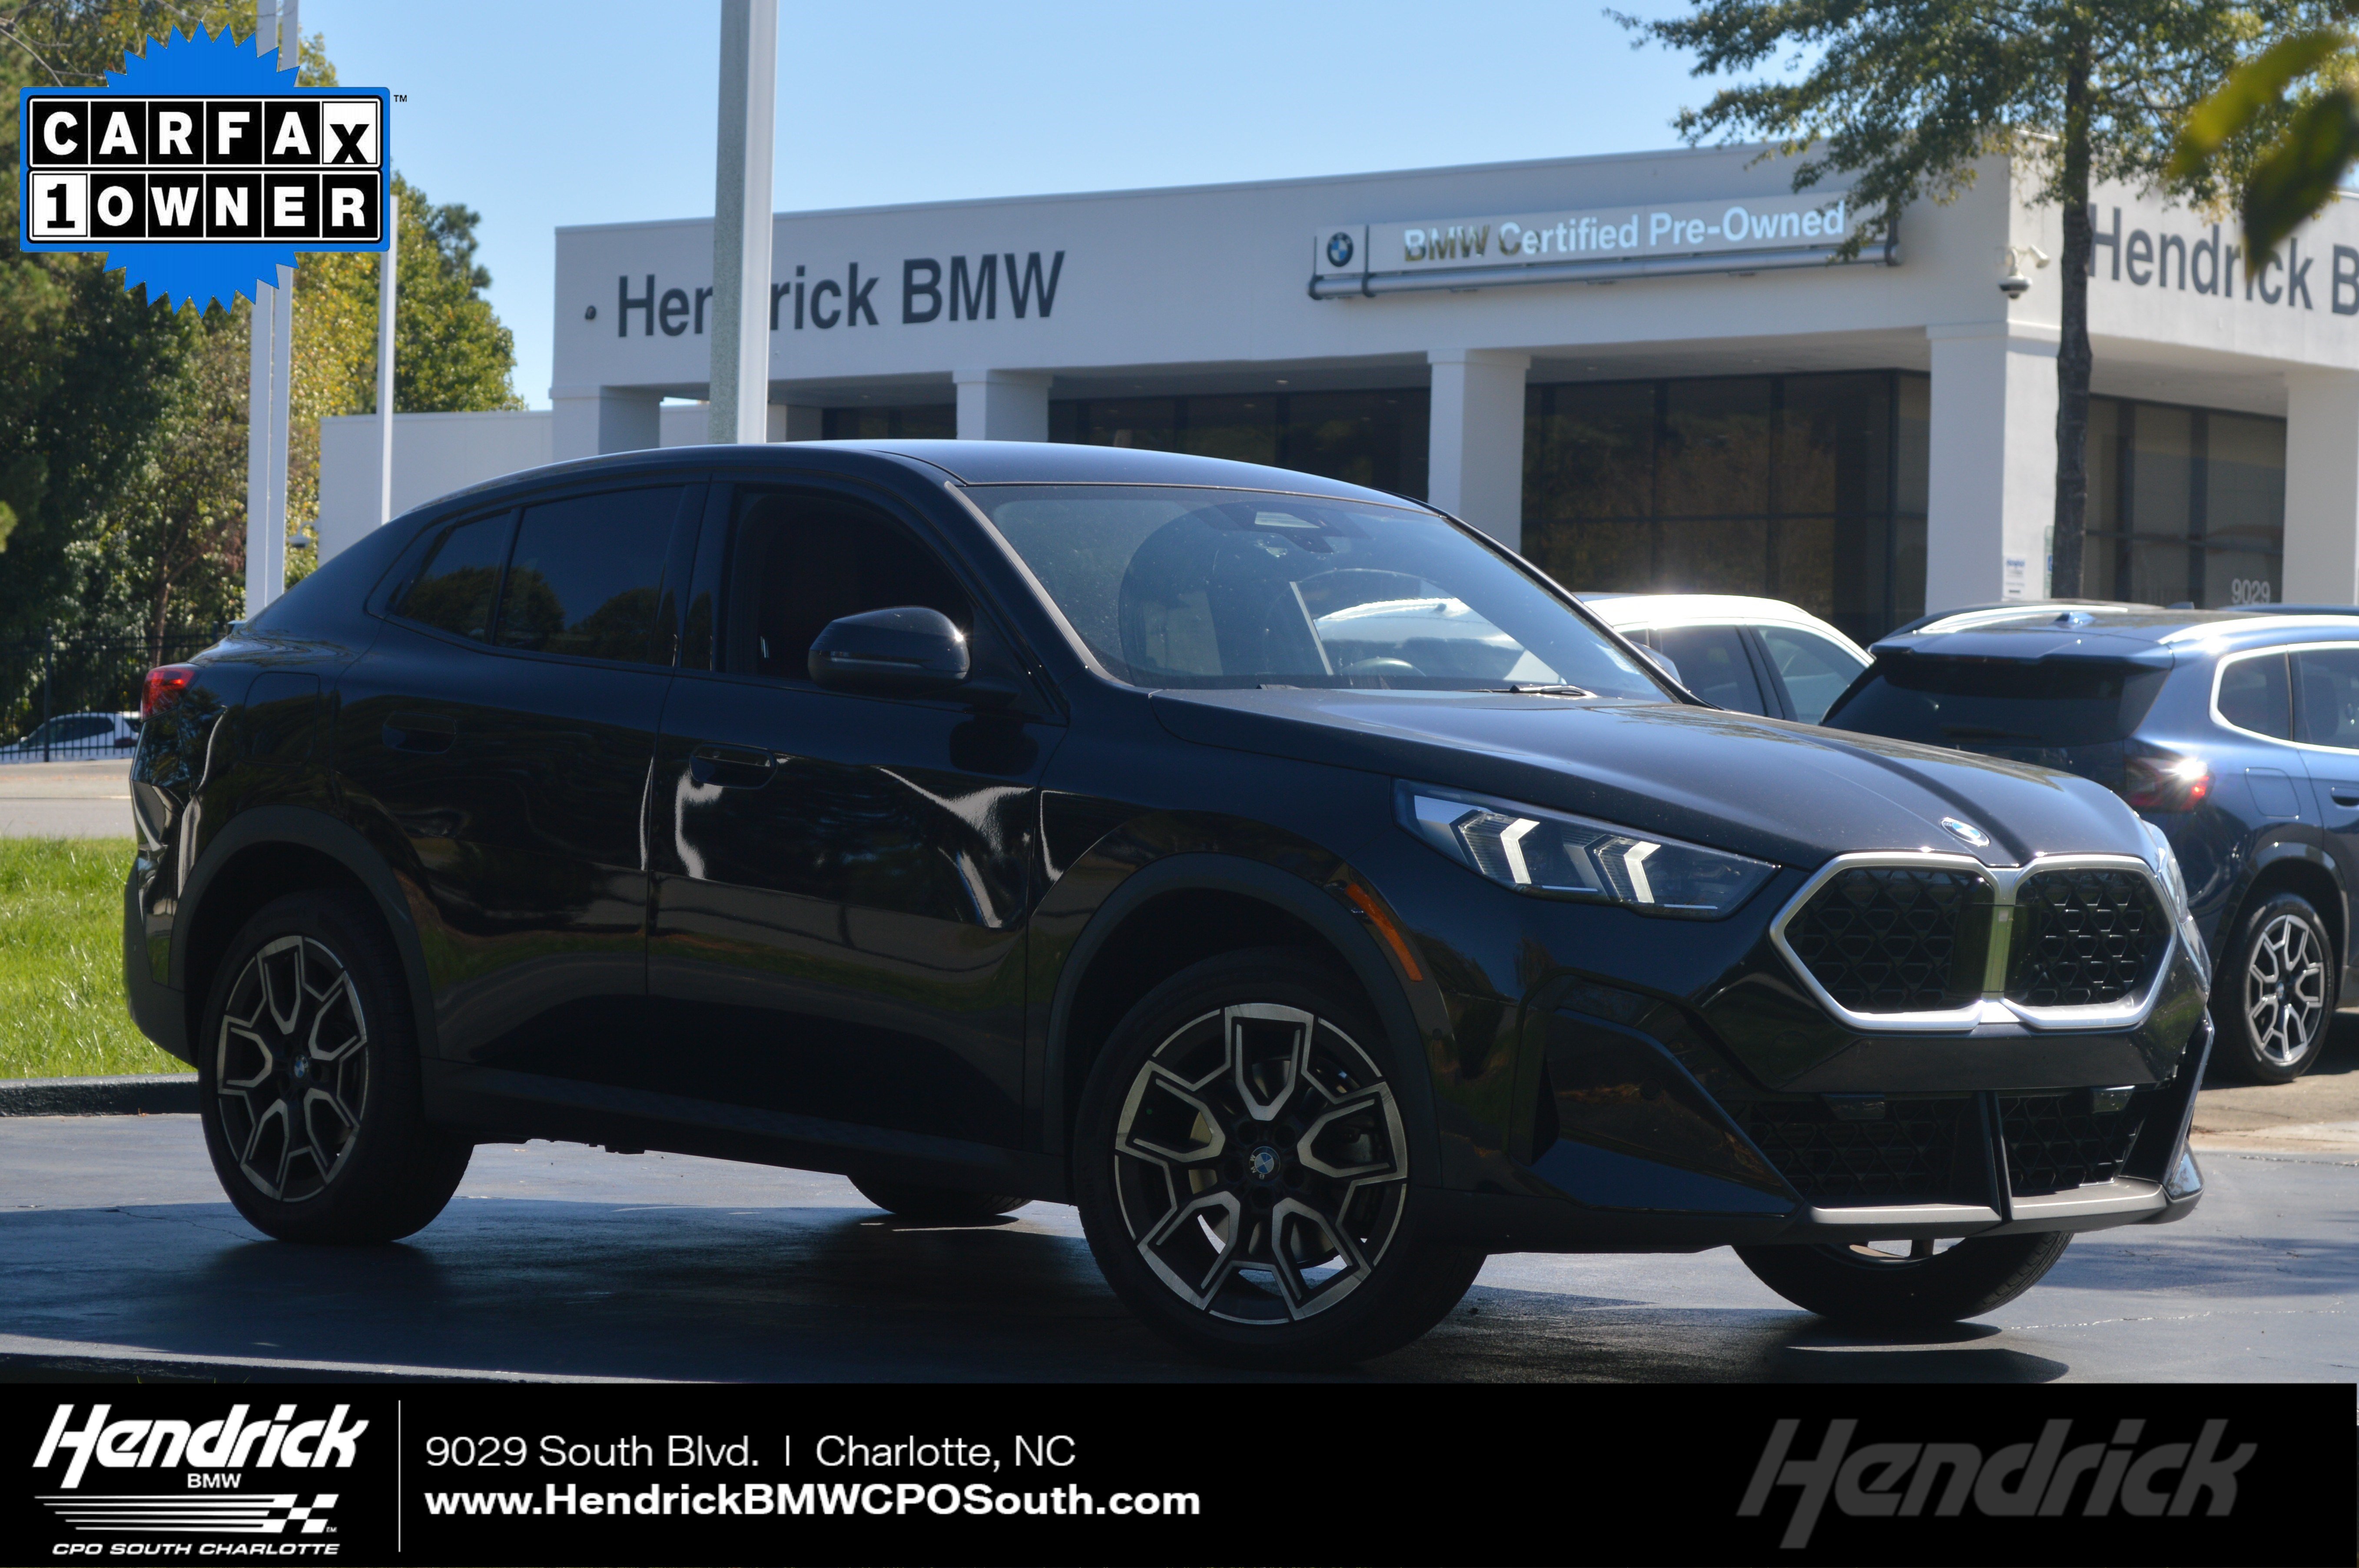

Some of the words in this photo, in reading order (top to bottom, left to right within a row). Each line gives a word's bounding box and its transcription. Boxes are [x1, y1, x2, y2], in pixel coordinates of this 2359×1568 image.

[1404, 224, 1490, 262] BMW
[1499, 215, 1639, 255] Certified
[1650, 200, 1845, 246] Pre-Owned
[902, 250, 1065, 324] BMW
[2231, 578, 2271, 604] 9029
